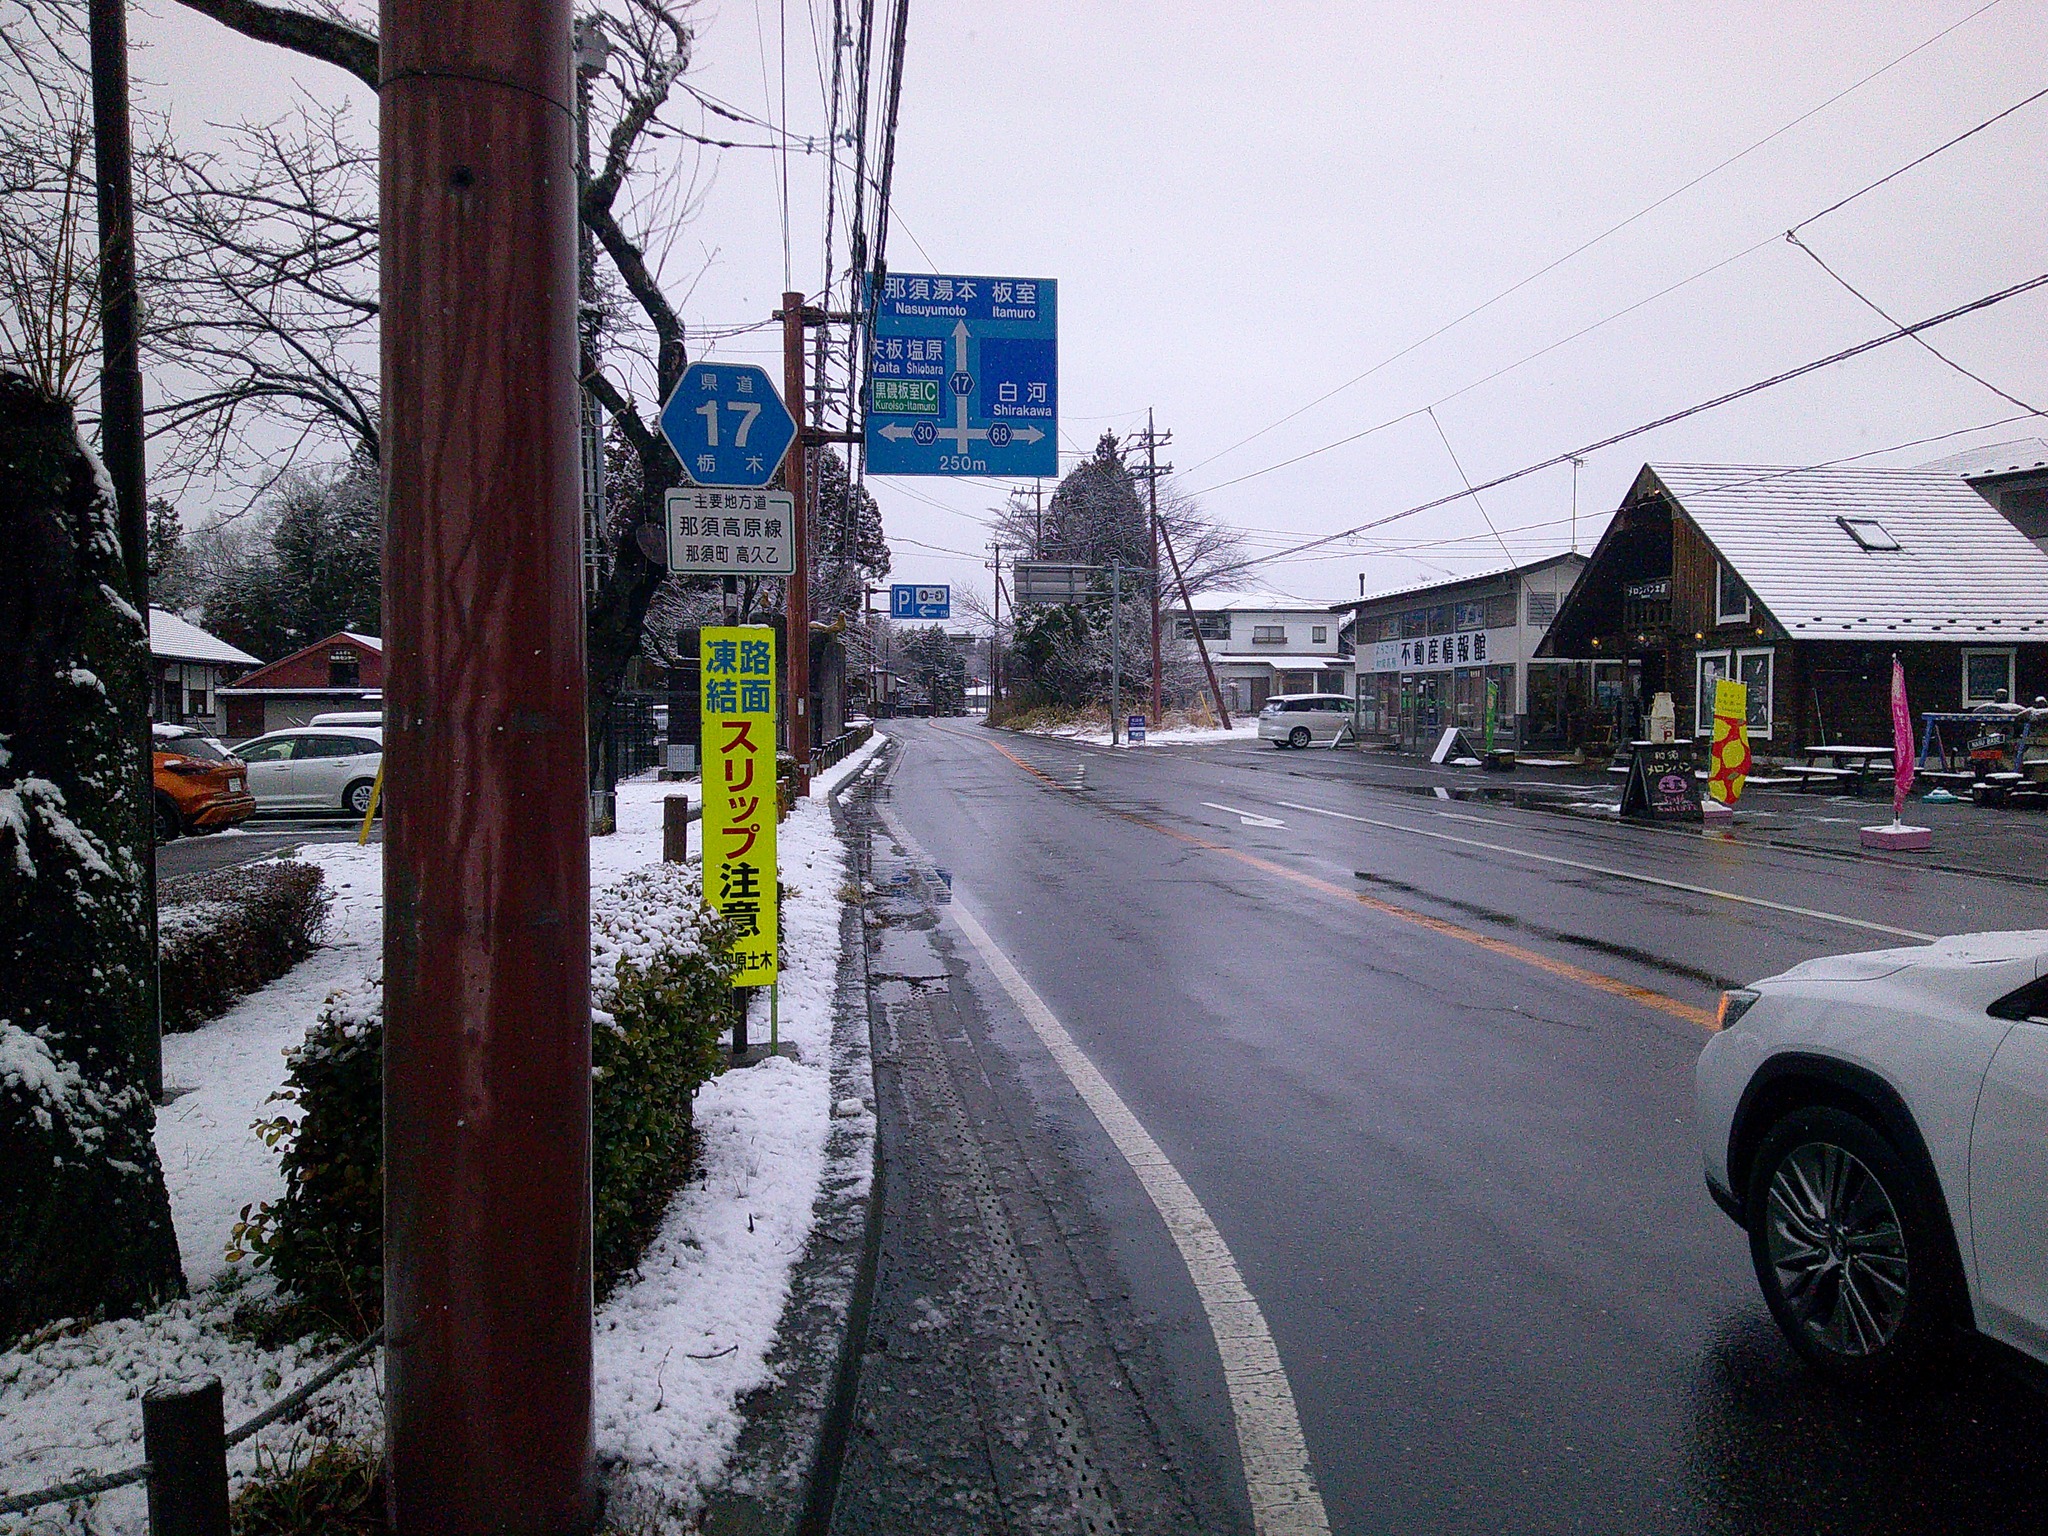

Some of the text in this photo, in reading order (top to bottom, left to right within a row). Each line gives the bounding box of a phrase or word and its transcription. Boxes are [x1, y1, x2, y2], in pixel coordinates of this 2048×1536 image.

[885, 278, 1036, 305] 那須湯本 板室
[895, 303, 1036, 319] Nasuyumoto Itamuro
[907, 340, 943, 361] 塩原
[873, 361, 944, 375] Yaita Shiobara
[700, 373, 754, 394] 県道
[955, 376, 968, 392] 17
[999, 382, 1048, 403] 白河
[875, 400, 936, 412] Kuroiso-Itamuro
[993, 404, 1052, 417] Shirakawa
[695, 399, 762, 448] 17
[917, 427, 932, 440] 30
[992, 427, 1008, 442] 68
[697, 454, 764, 475] 栃木
[939, 456, 987, 471] 250m
[694, 493, 768, 510] 主要地方道
[680, 516, 783, 538] 那須高原線
[686, 546, 780, 564] 那須町 高久乙
[898, 590, 910, 613] P
[1401, 633, 1487, 667] 不動産情報館
[1647, 761, 1692, 776] メロンパン
